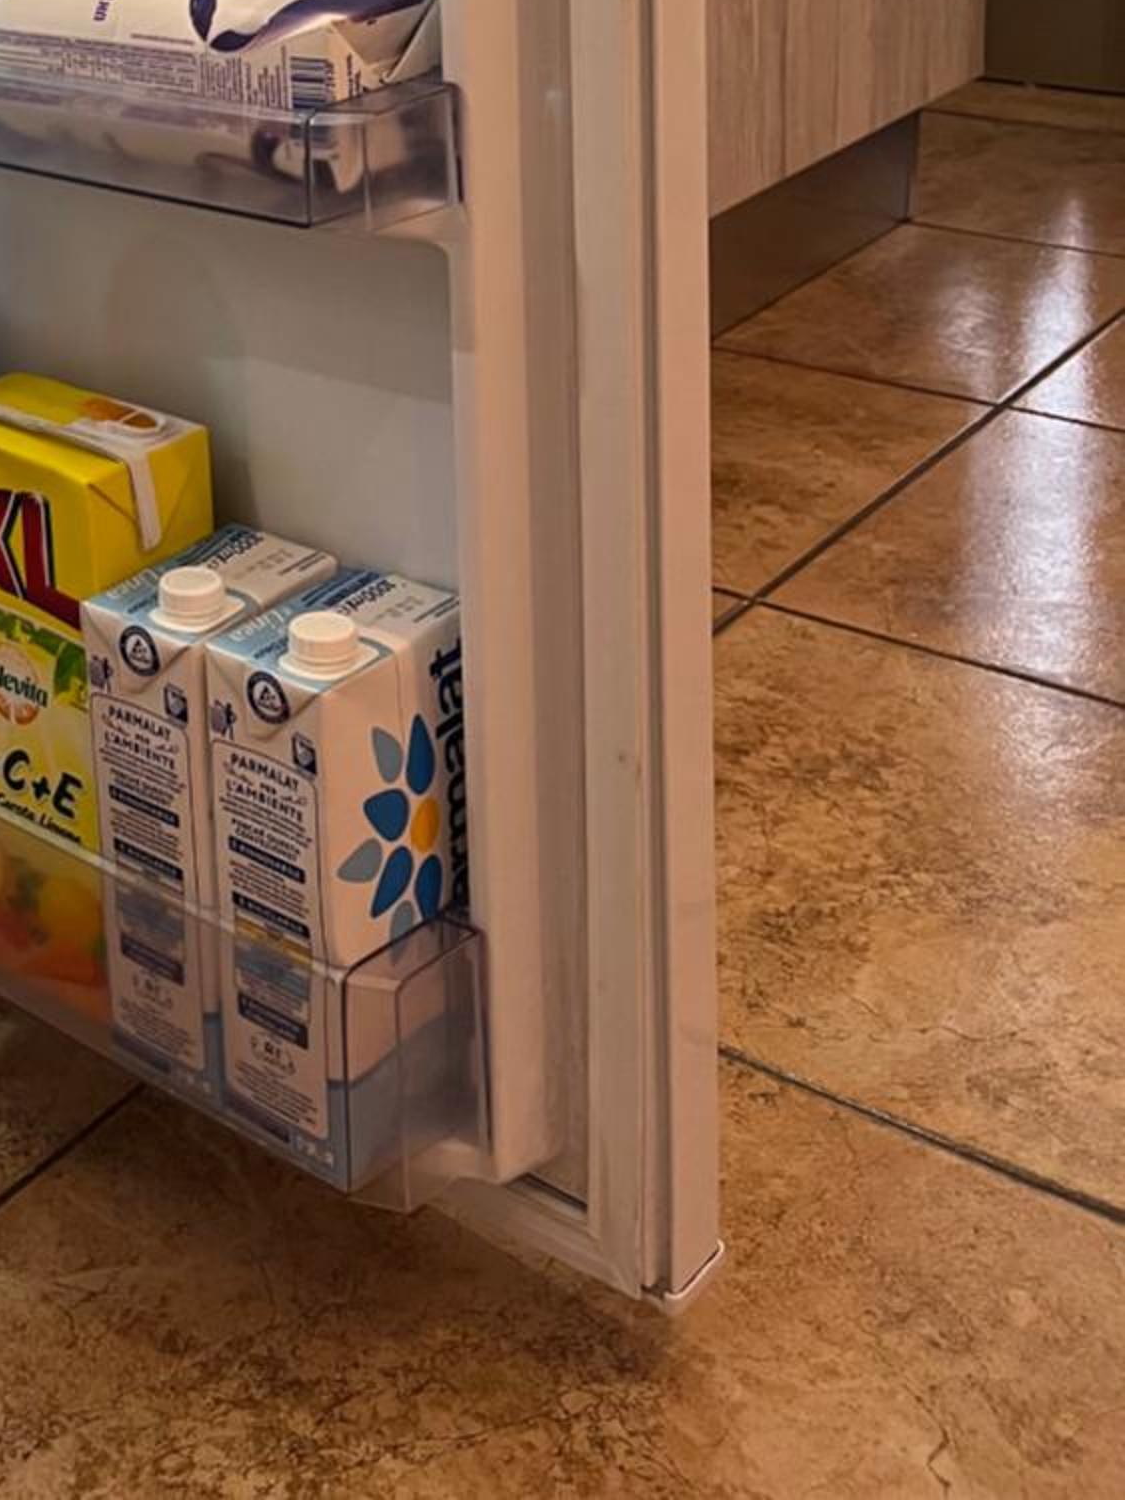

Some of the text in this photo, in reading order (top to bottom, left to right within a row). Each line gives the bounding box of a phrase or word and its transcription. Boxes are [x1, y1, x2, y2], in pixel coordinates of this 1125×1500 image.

[108, 704, 172, 742] PARMALAT
[230, 752, 299, 792] PARMALAT
[226, 779, 303, 822] L'AMBIENTE
